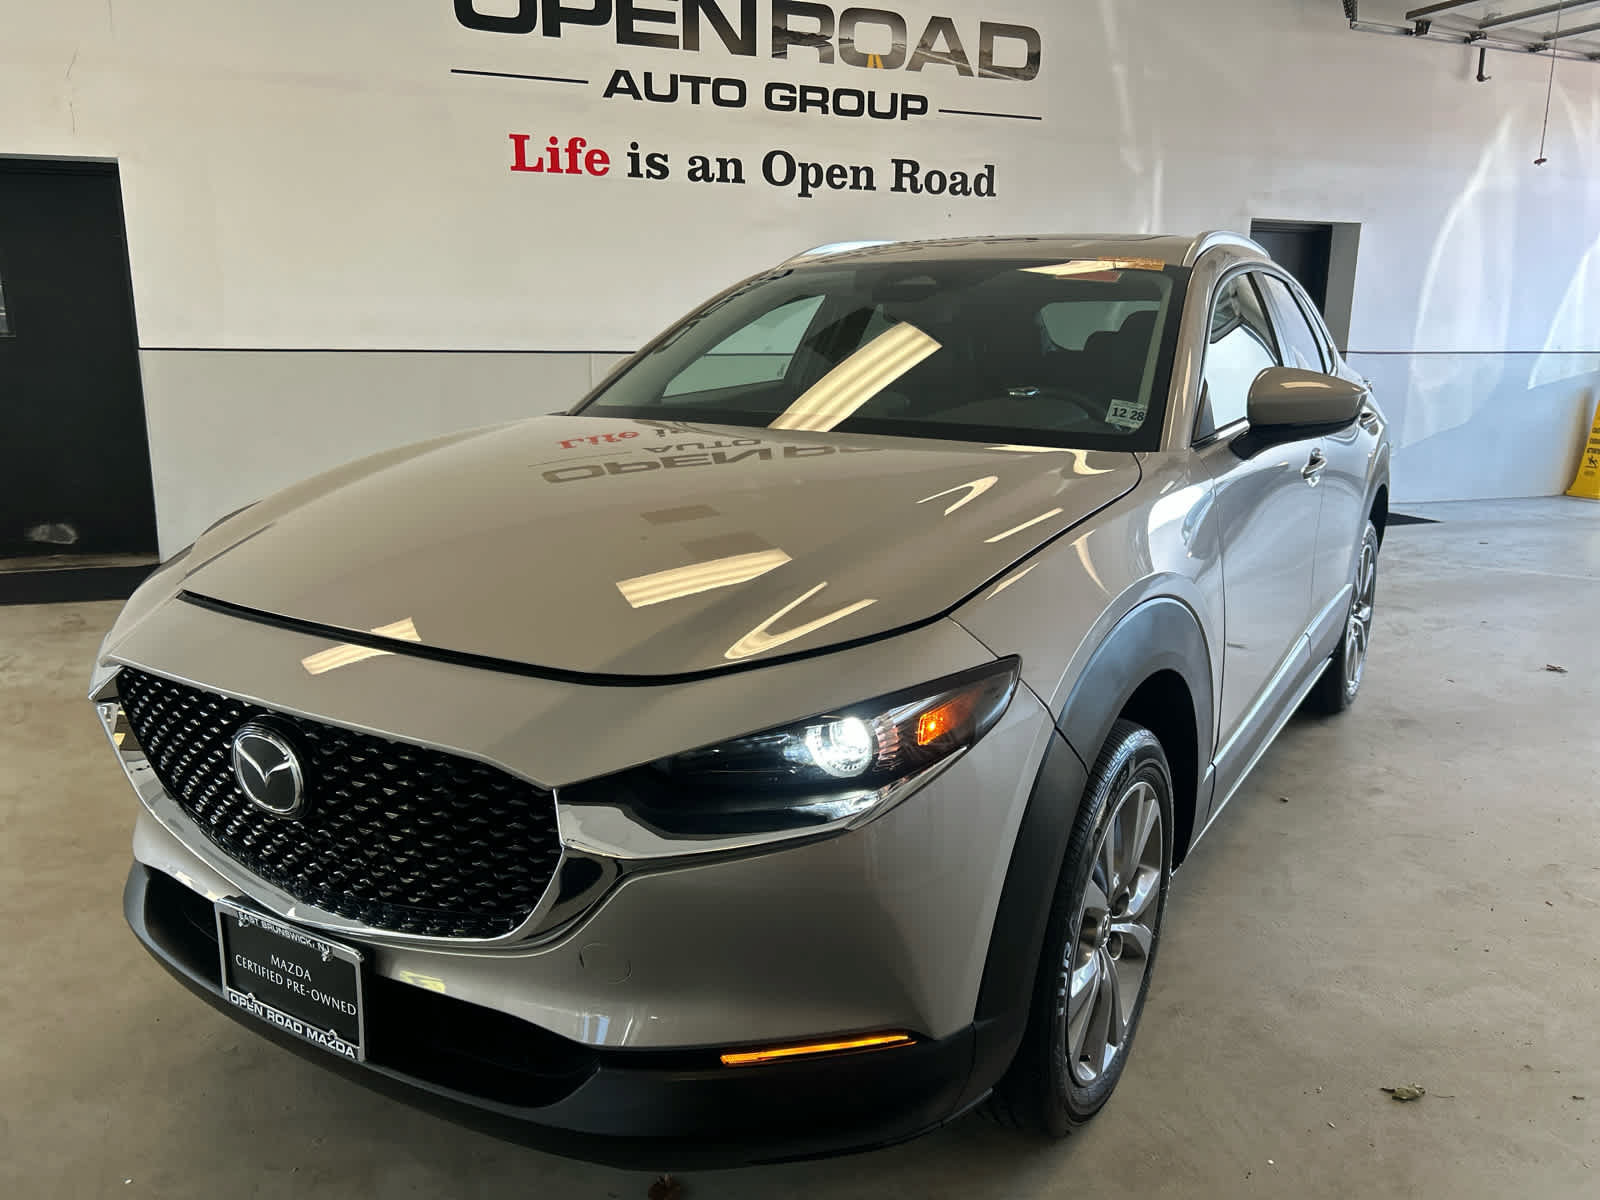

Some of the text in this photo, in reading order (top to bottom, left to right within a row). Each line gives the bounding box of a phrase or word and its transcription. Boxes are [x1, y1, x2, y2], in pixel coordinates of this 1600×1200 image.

[602, 69, 929, 121] AUTO GROUP
[508, 133, 997, 199] Life is an Open Road
[1112, 407, 1145, 422] 12 28
[235, 954, 357, 1016] CERTIFIED PRE-OWNED
[271, 954, 312, 982] MAZDA
[230, 993, 356, 1059] OPEN ROAD MAZDA
